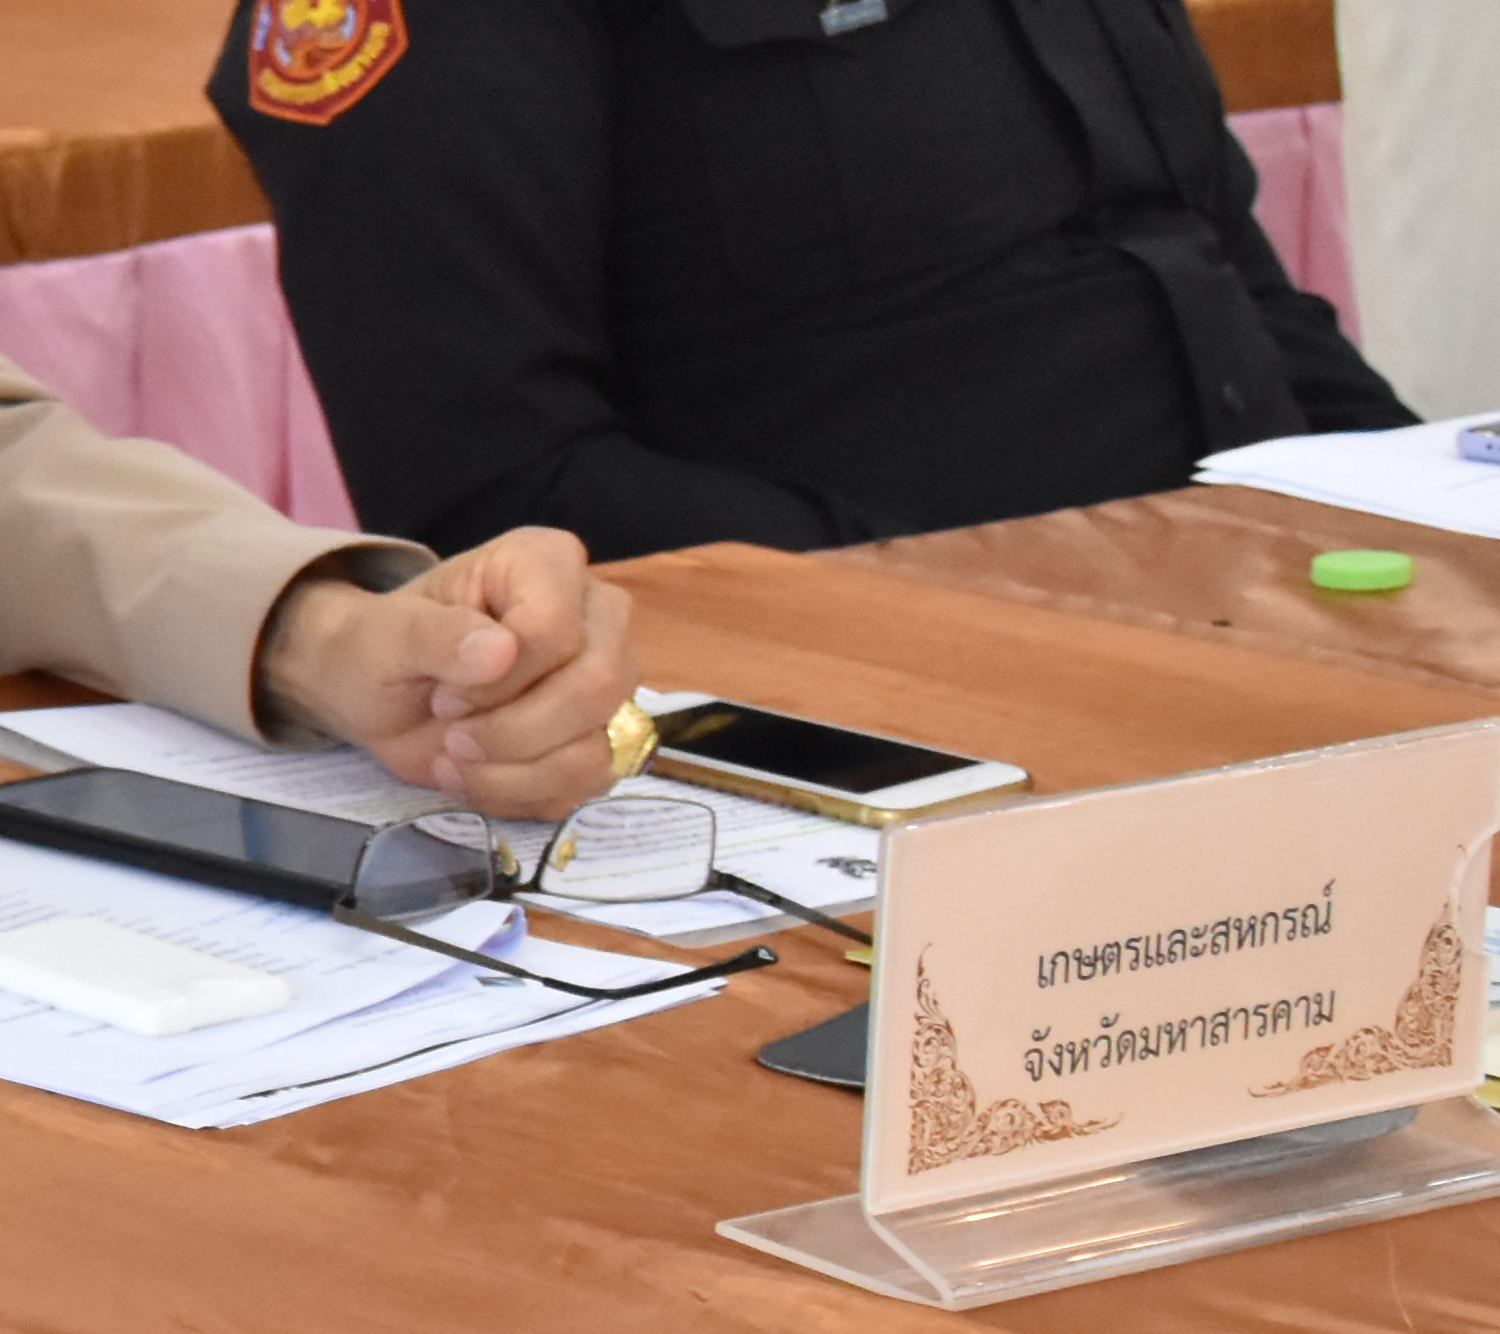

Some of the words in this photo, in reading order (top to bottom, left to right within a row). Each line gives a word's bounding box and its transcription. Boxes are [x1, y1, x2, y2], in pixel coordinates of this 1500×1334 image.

[1036, 878, 1336, 989] เกษตรและสหกรณ์
[1023, 989, 1337, 1083] จังหวัดมหาสารคาม
